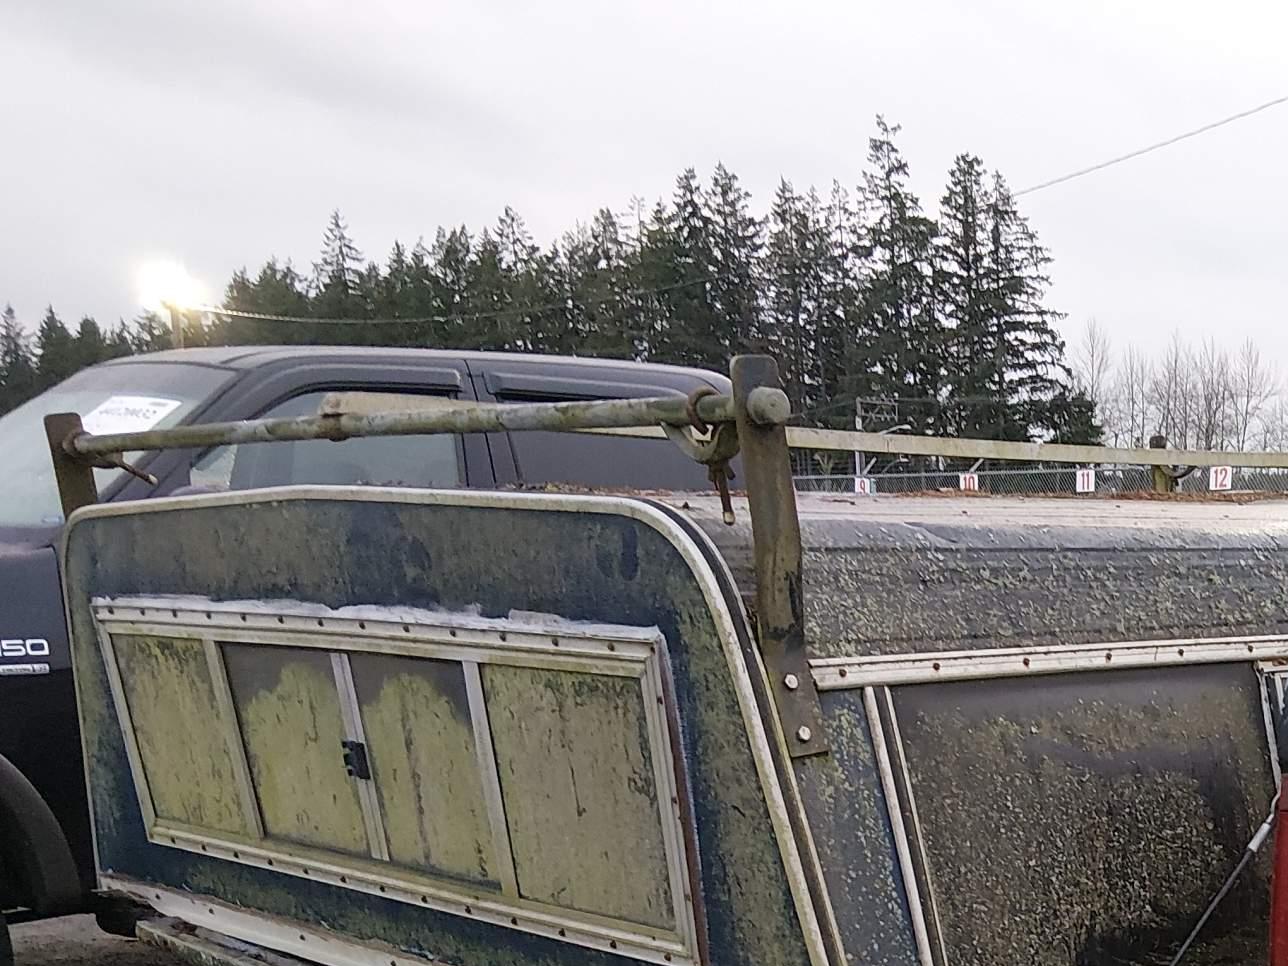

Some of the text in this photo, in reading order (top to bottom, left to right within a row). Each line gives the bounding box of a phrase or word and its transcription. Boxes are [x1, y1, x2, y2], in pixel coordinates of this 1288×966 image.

[963, 476, 975, 491] 10
[1081, 472, 1090, 490] 11
[1214, 467, 1228, 488] 12
[860, 480, 866, 494] 9
